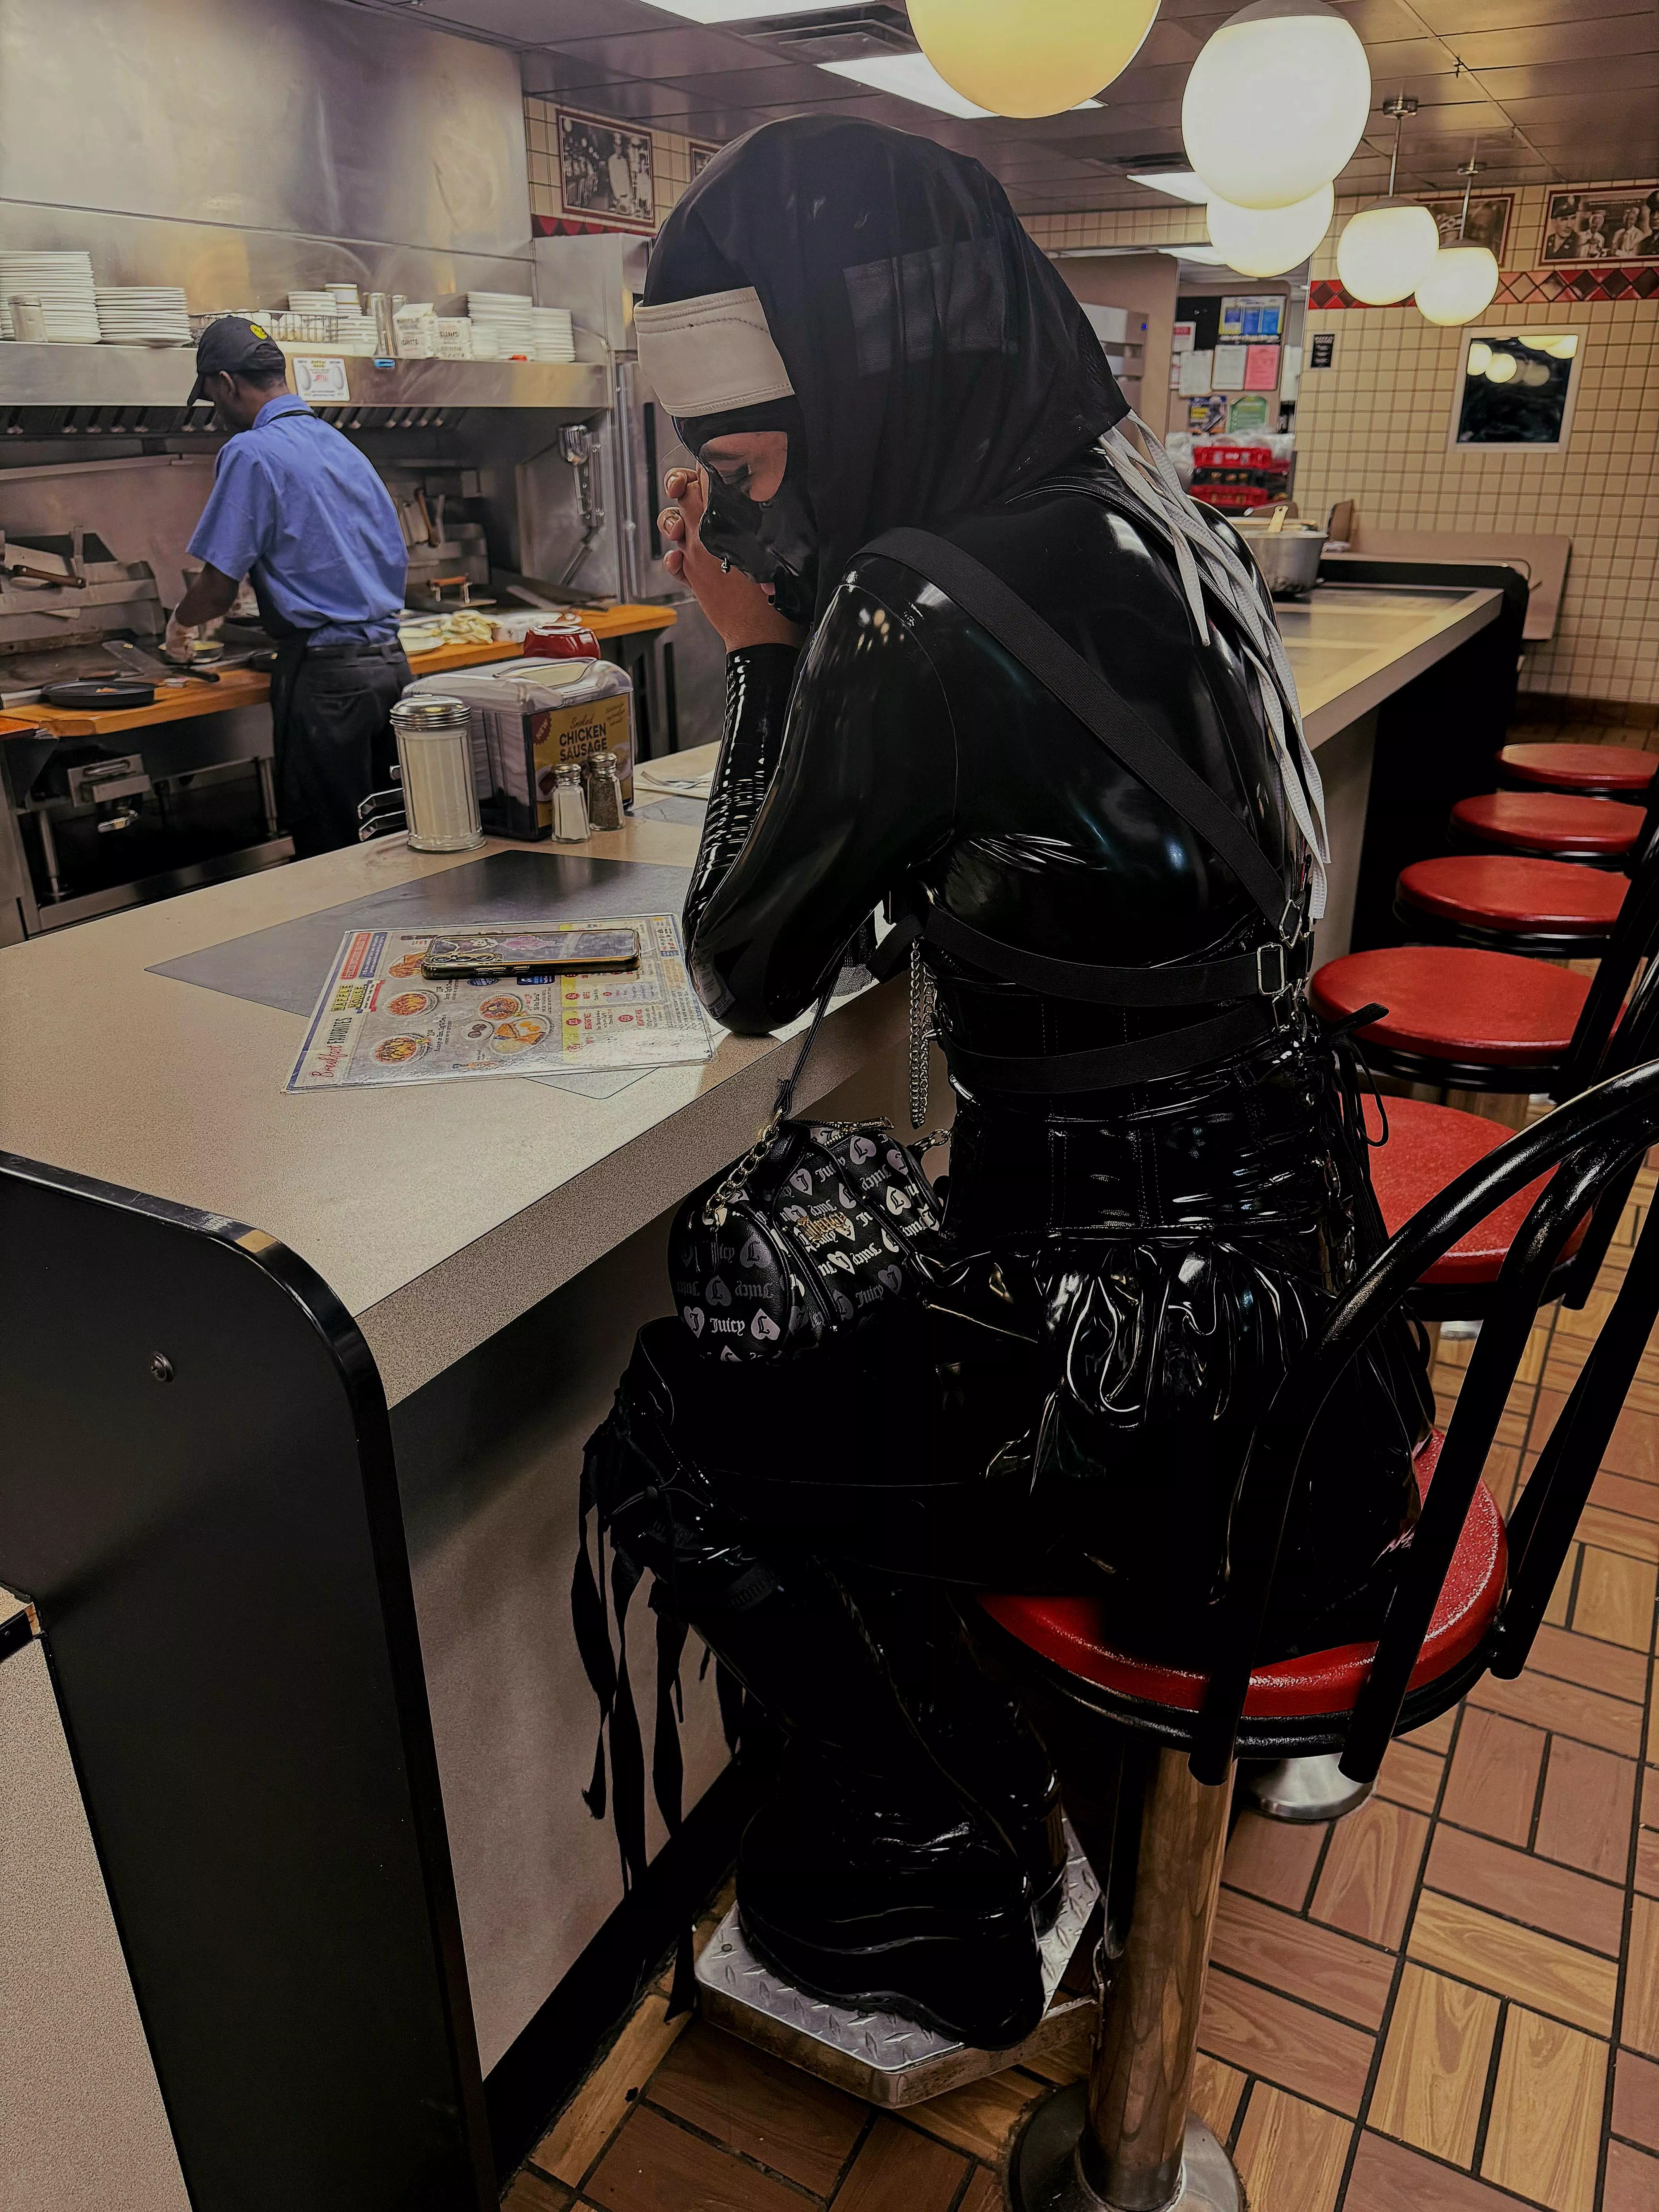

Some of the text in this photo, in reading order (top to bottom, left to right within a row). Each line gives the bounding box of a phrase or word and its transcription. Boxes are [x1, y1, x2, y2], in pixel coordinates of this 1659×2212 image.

[536, 719, 548, 740] NEW
[559, 723, 606, 746] CHICKEN
[560, 738, 608, 761] SAUSAGE
[348, 986, 366, 1010] HOUSE
[311, 1017, 353, 1077] Breakfast FAVORITES
[709, 1317, 745, 1336] Juicy
